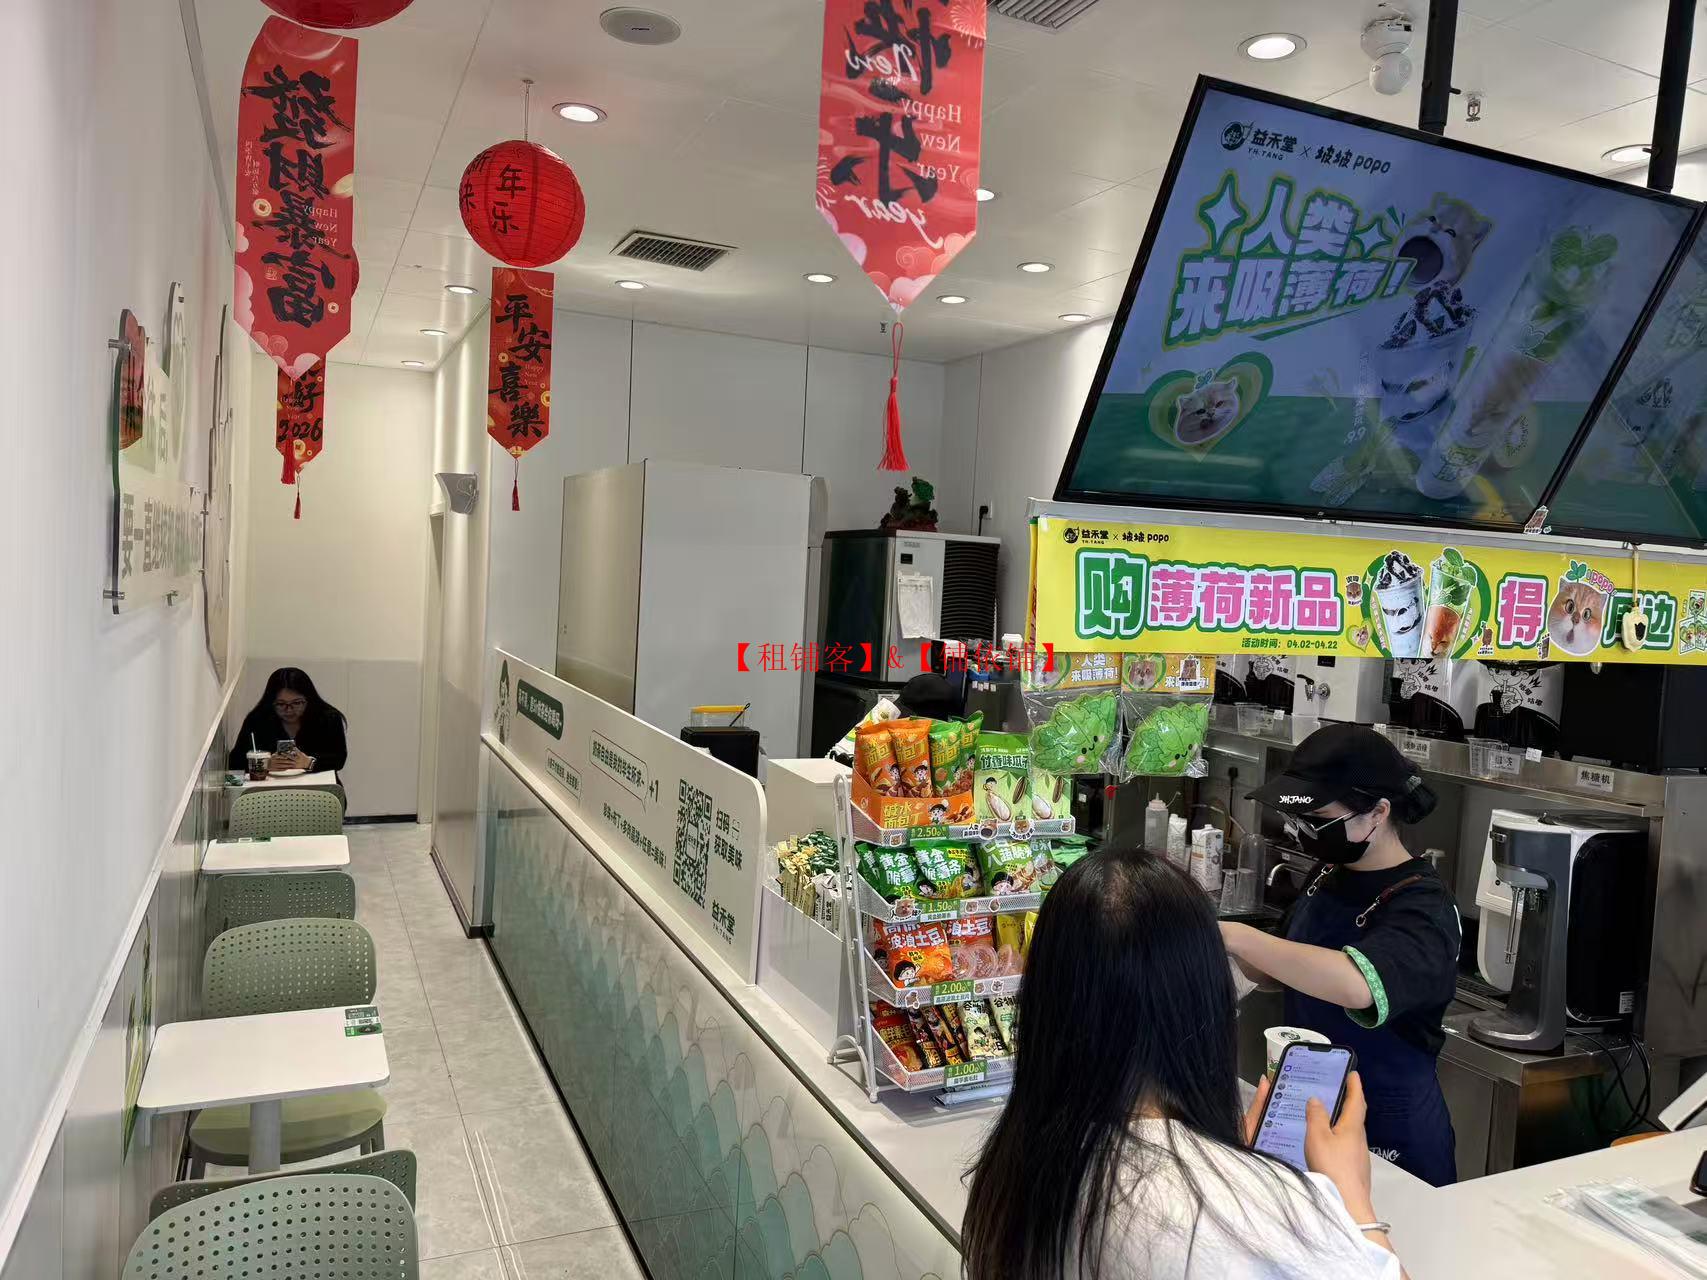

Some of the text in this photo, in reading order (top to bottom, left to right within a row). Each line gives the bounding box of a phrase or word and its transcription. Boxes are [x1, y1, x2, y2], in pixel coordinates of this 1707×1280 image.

[1251, 128, 1297, 153] 益禾堂
[1353, 155, 1391, 174] popo
[1241, 181, 1356, 257] 人类
[488, 293, 551, 439] 平安喜樂
[277, 418, 323, 442] 2026
[1081, 529, 1109, 540] 益禾堂
[1499, 579, 1545, 643] 得
[1081, 653, 1106, 667] 人类
[716, 808, 730, 834] 扫码
[714, 834, 743, 871] 获取美味
[711, 900, 736, 937] 益禾堂
[941, 982, 962, 994] 2.00
[954, 1063, 975, 1076] 1.00
